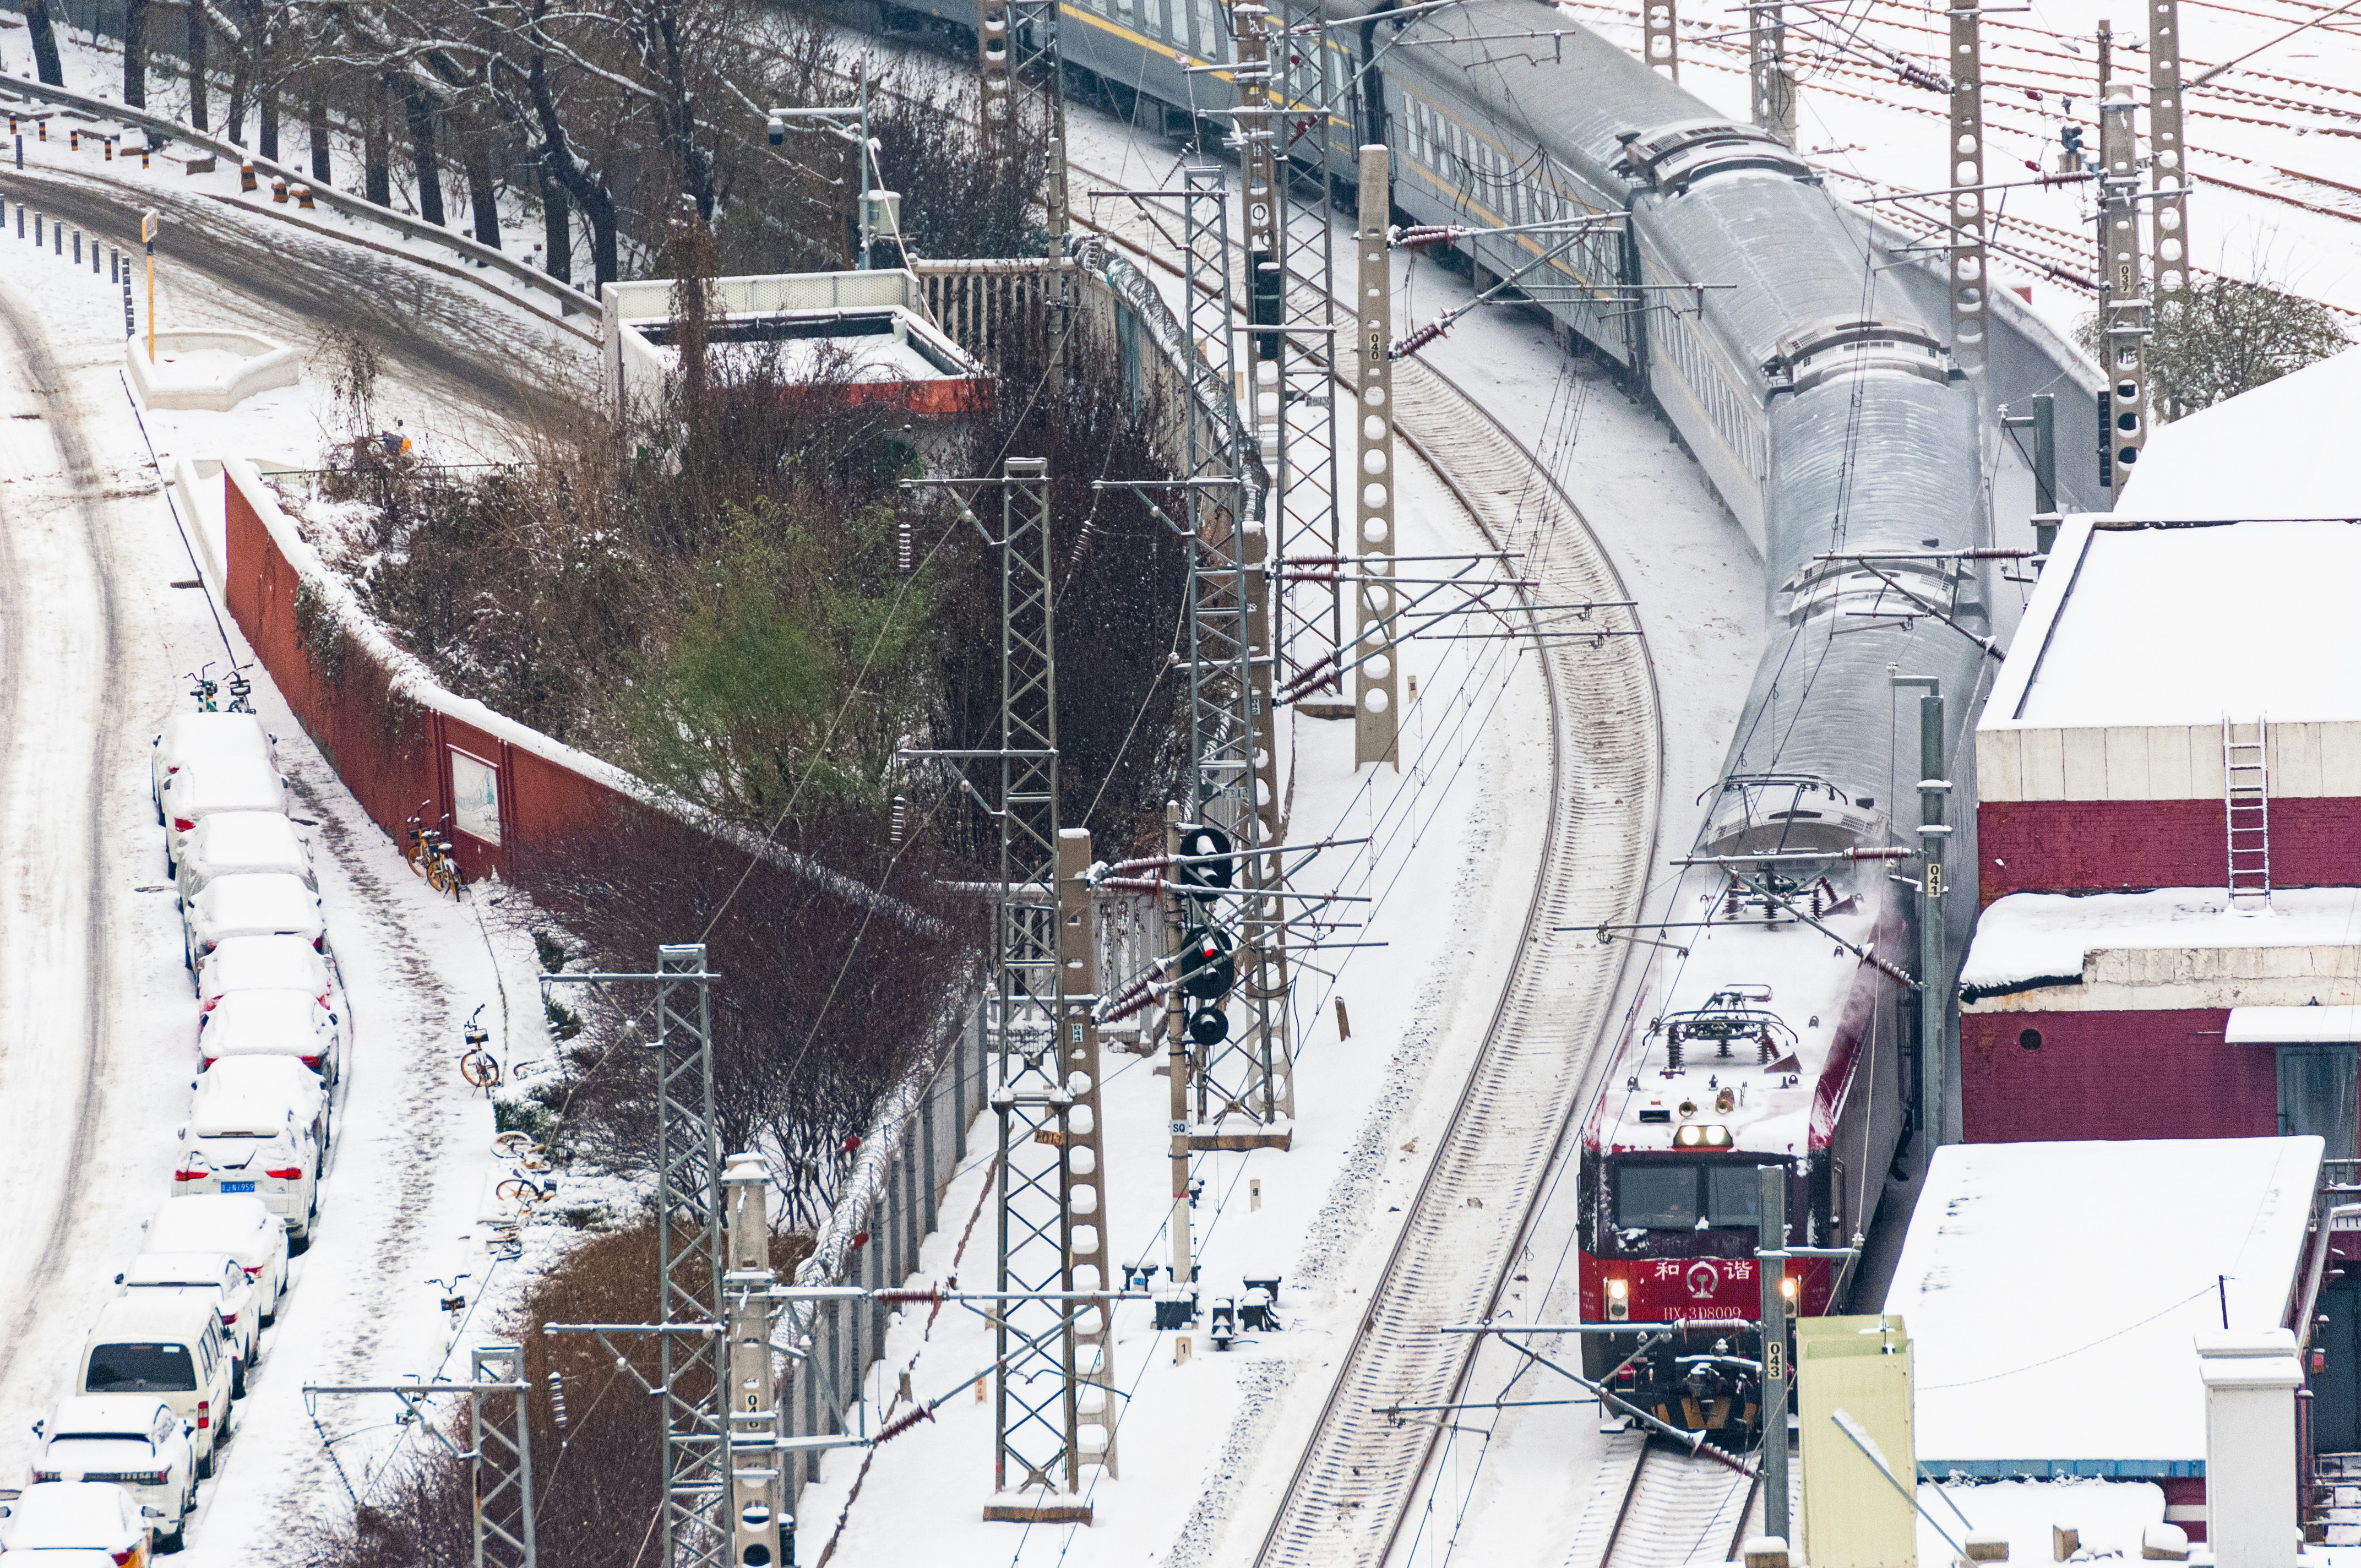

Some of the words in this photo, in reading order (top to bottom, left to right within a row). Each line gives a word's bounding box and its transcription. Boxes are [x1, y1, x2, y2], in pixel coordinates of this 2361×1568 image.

[1930, 865, 1939, 895] 041
[1173, 1123, 1185, 1133] SQ
[1654, 1261, 1679, 1281] 和
[1723, 1261, 1753, 1280] 谐
[1664, 1306, 1742, 1321] HX3D8009
[1182, 1343, 1185, 1354] 1
[1770, 1344, 1780, 1378] 043
